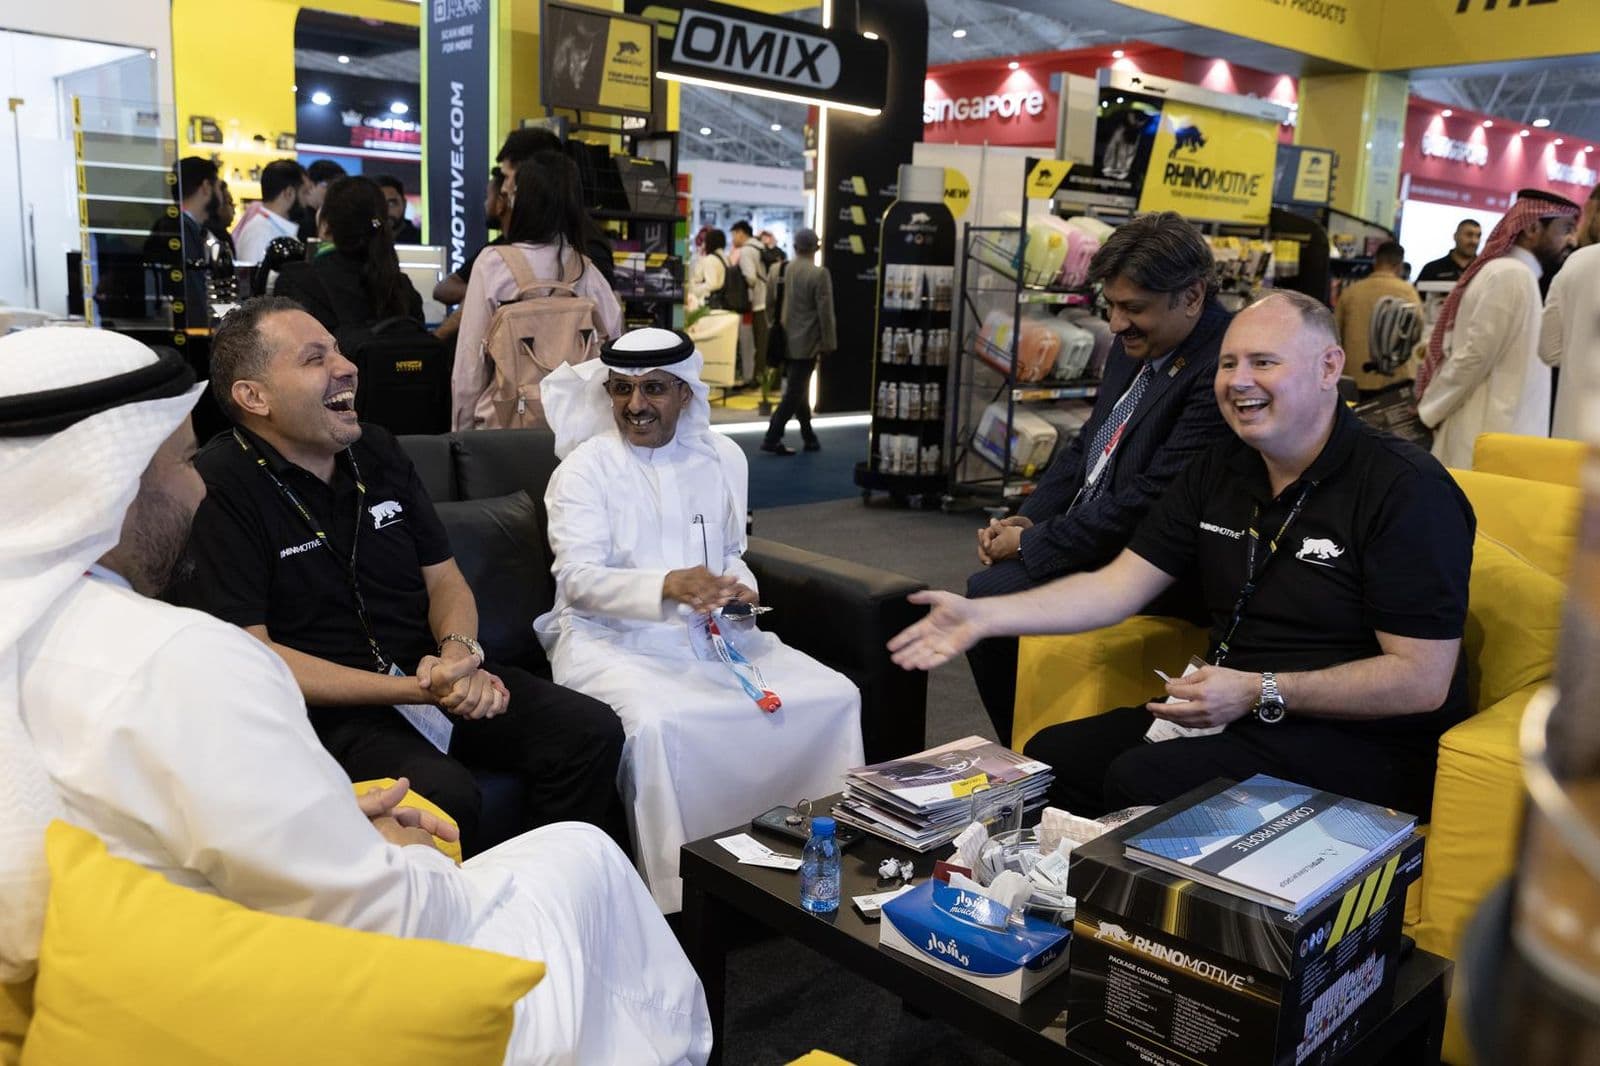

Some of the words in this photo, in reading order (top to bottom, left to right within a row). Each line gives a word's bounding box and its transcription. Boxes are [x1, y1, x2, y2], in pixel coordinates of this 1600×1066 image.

[681, 15, 828, 83] OMIX
[944, 188, 970, 199] NEW
[1268, 806, 1315, 833] COMPANY
[1231, 828, 1276, 853] PROFILE
[1107, 954, 1137, 972] PACKAGE
